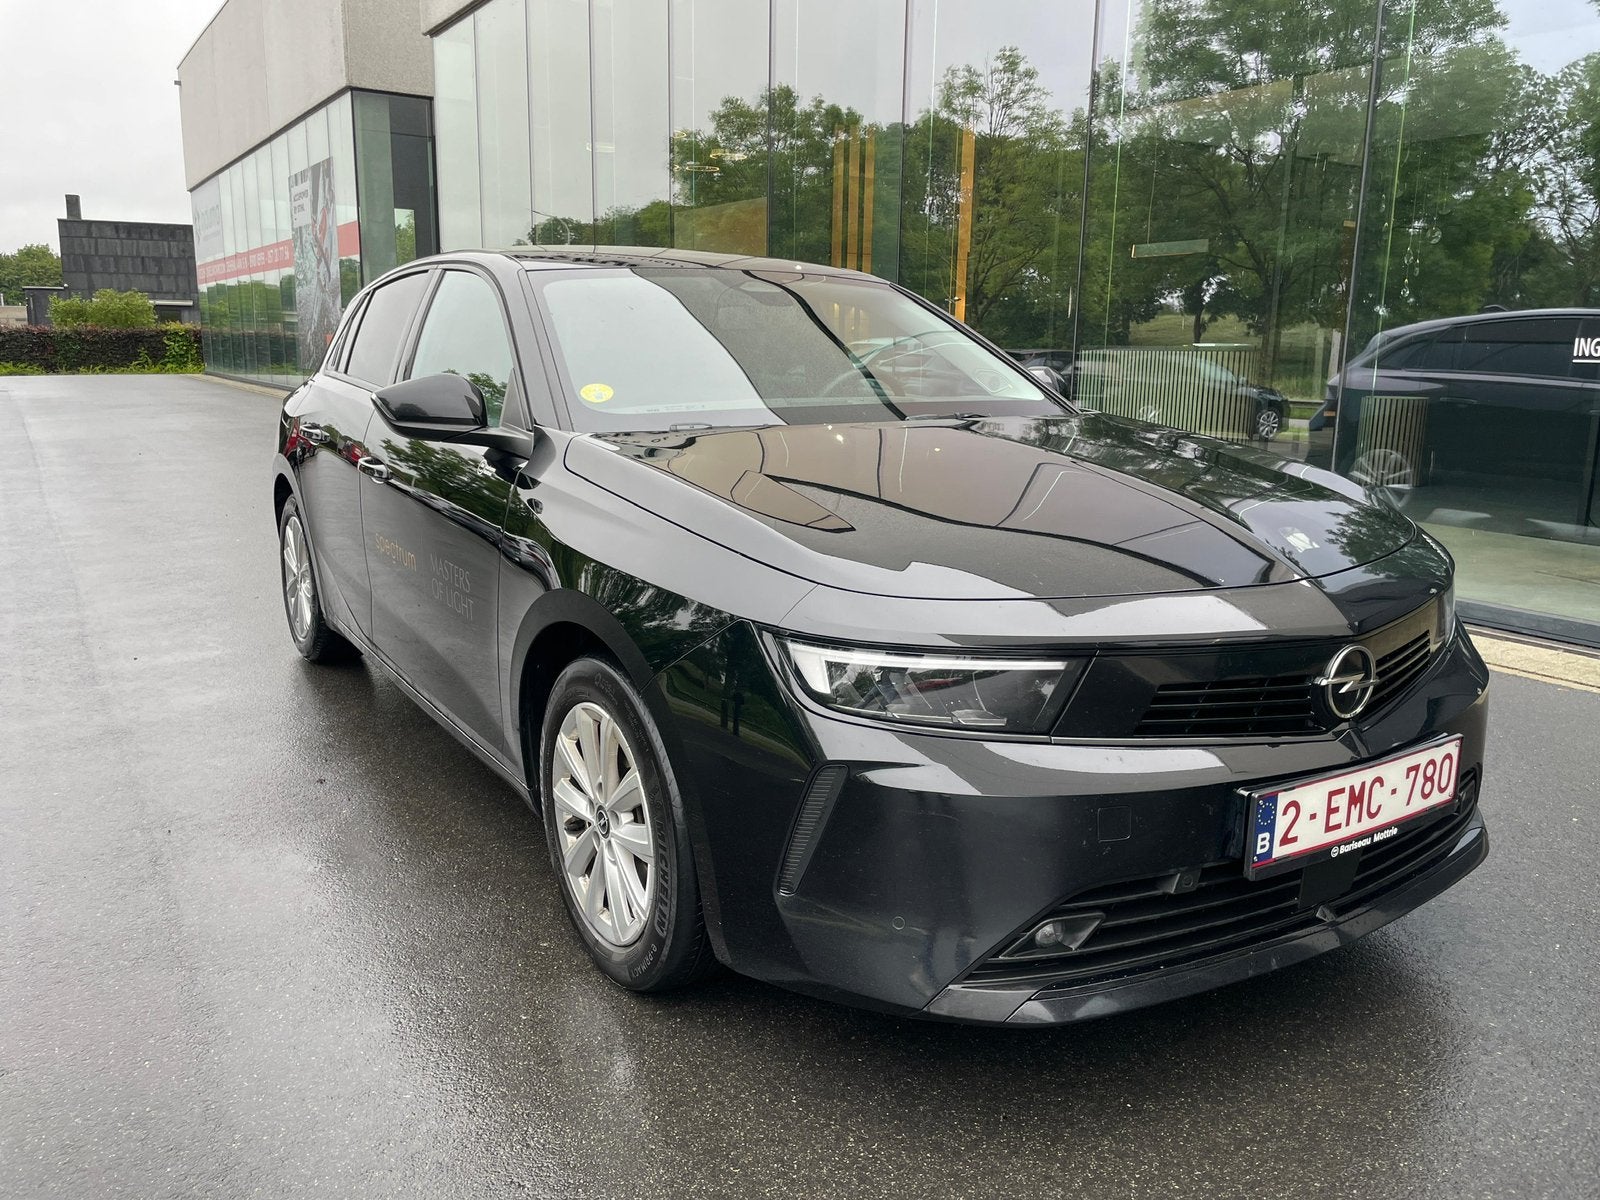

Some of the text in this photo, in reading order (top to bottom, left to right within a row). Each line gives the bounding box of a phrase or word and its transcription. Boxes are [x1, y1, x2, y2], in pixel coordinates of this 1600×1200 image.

[430, 554, 471, 593] MASTERS
[431, 577, 474, 621] OF LIGHT
[1278, 752, 1454, 848] 2-EMC-780
[1257, 831, 1270, 854] B
[1339, 826, 1398, 854] Bariseau Mottrie
